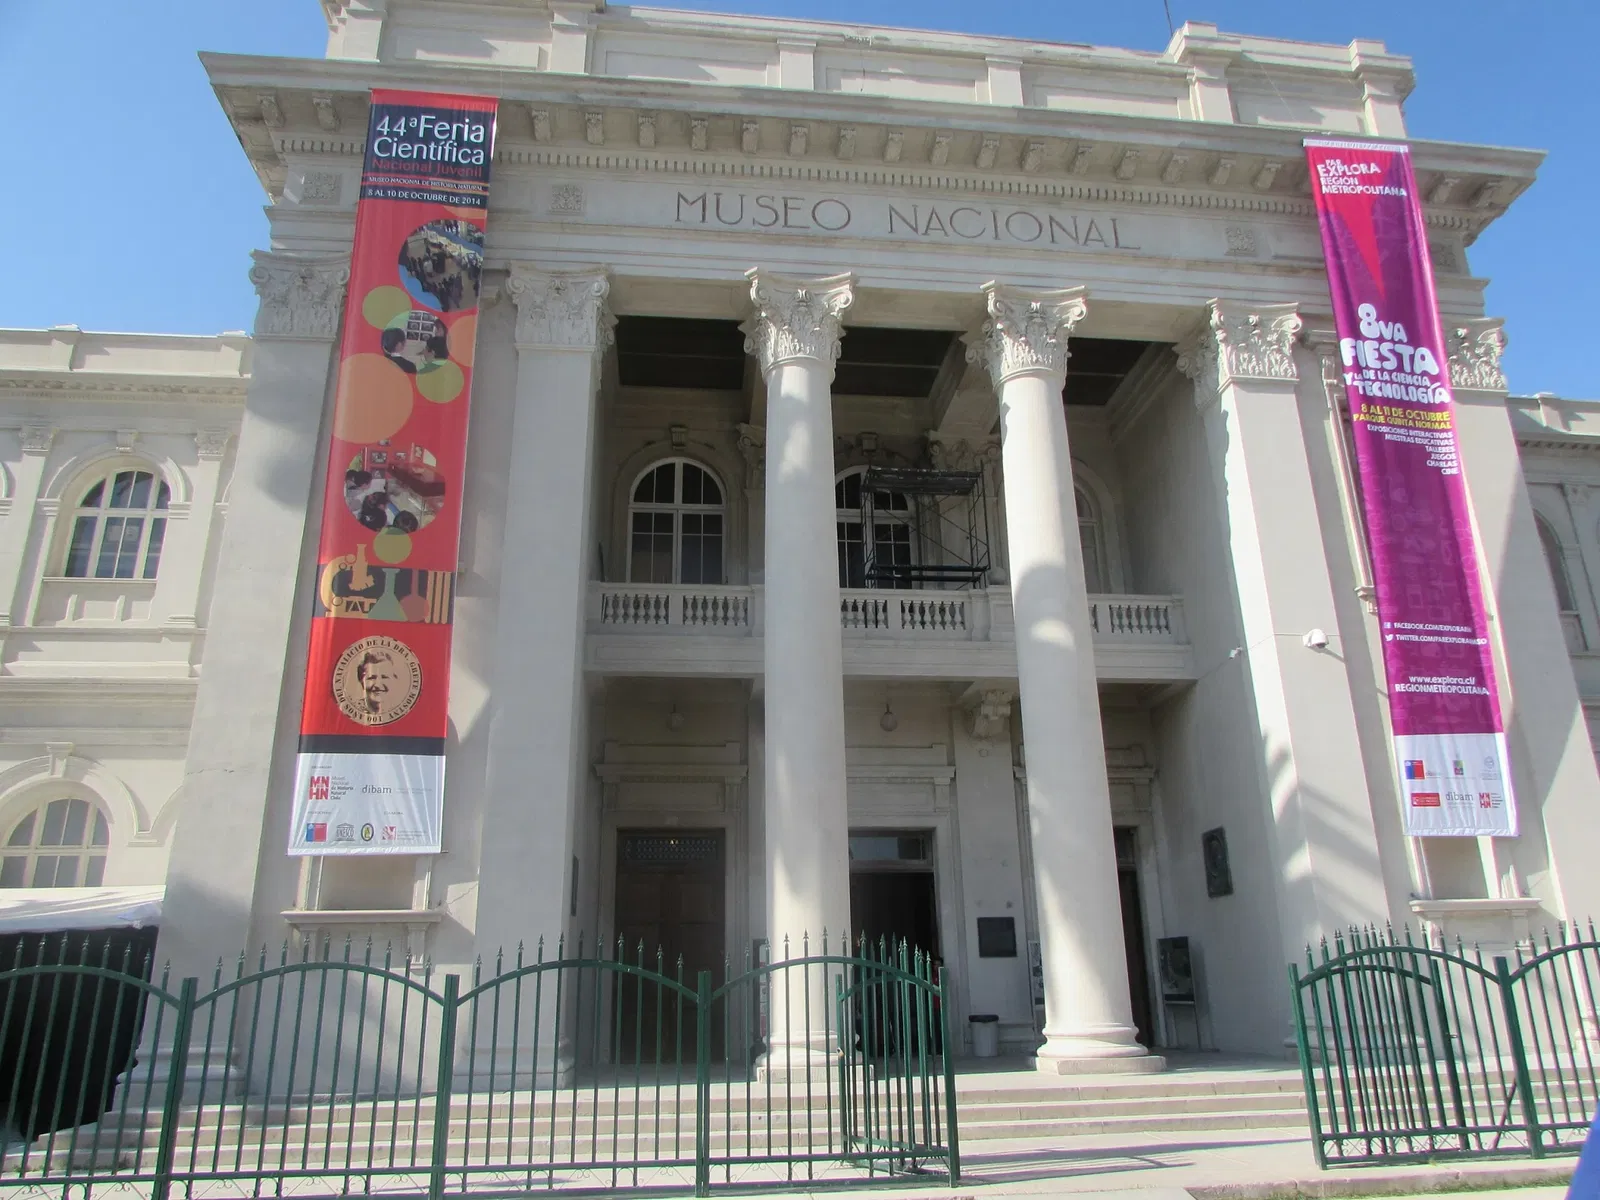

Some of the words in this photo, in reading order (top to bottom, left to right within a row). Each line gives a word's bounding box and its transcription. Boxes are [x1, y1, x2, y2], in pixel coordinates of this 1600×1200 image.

[373, 136, 484, 165] Científica
[371, 159, 432, 173] Nacional
[436, 163, 482, 177] Juvenil
[1317, 163, 1381, 177] EXPLORA
[430, 181, 457, 189] HISTORIA
[1321, 185, 1407, 197] METROPOLITANA
[374, 189, 385, 197] AL
[398, 191, 409, 199] DE
[410, 191, 448, 202] OCTUBRE
[449, 195, 461, 204] DE
[462, 197, 481, 205] 2014
[674, 191, 851, 231] MUSEO
[888, 203, 1141, 250] NACIONAL
[1357, 303, 1408, 343] 8VA
[1340, 338, 1440, 376] FIESTA
[1363, 369, 1376, 380] DE
[1378, 371, 1390, 381] LA
[1391, 372, 1431, 387] CIENCIA
[1343, 372, 1353, 386] Y
[1353, 381, 1451, 404] TECNOLOGÍA
[1361, 403, 1368, 413] 8
[1370, 405, 1383, 415] AL
[1383, 406, 1391, 415] 11
[1391, 407, 1404, 417] DE
[1405, 409, 1450, 421] OCTUBRE
[1353, 414, 1386, 424] PARQUE
[1386, 417, 1415, 427] QUINTA
[1415, 421, 1452, 430] NORMAL
[1367, 424, 1409, 435] EXPOSICIONES
[1409, 429, 1453, 439] INTERACTIVAS
[1385, 434, 1415, 443] MUESTRAS
[1415, 437, 1455, 446] EDUCATIVAS
[335, 643, 364, 684] NATALICIO
[381, 639, 391, 647] LA
[409, 661, 419, 690] GRETE
[310, 776, 330, 788] MN
[361, 784, 392, 794] dibam
[1445, 791, 1474, 801] dibam
